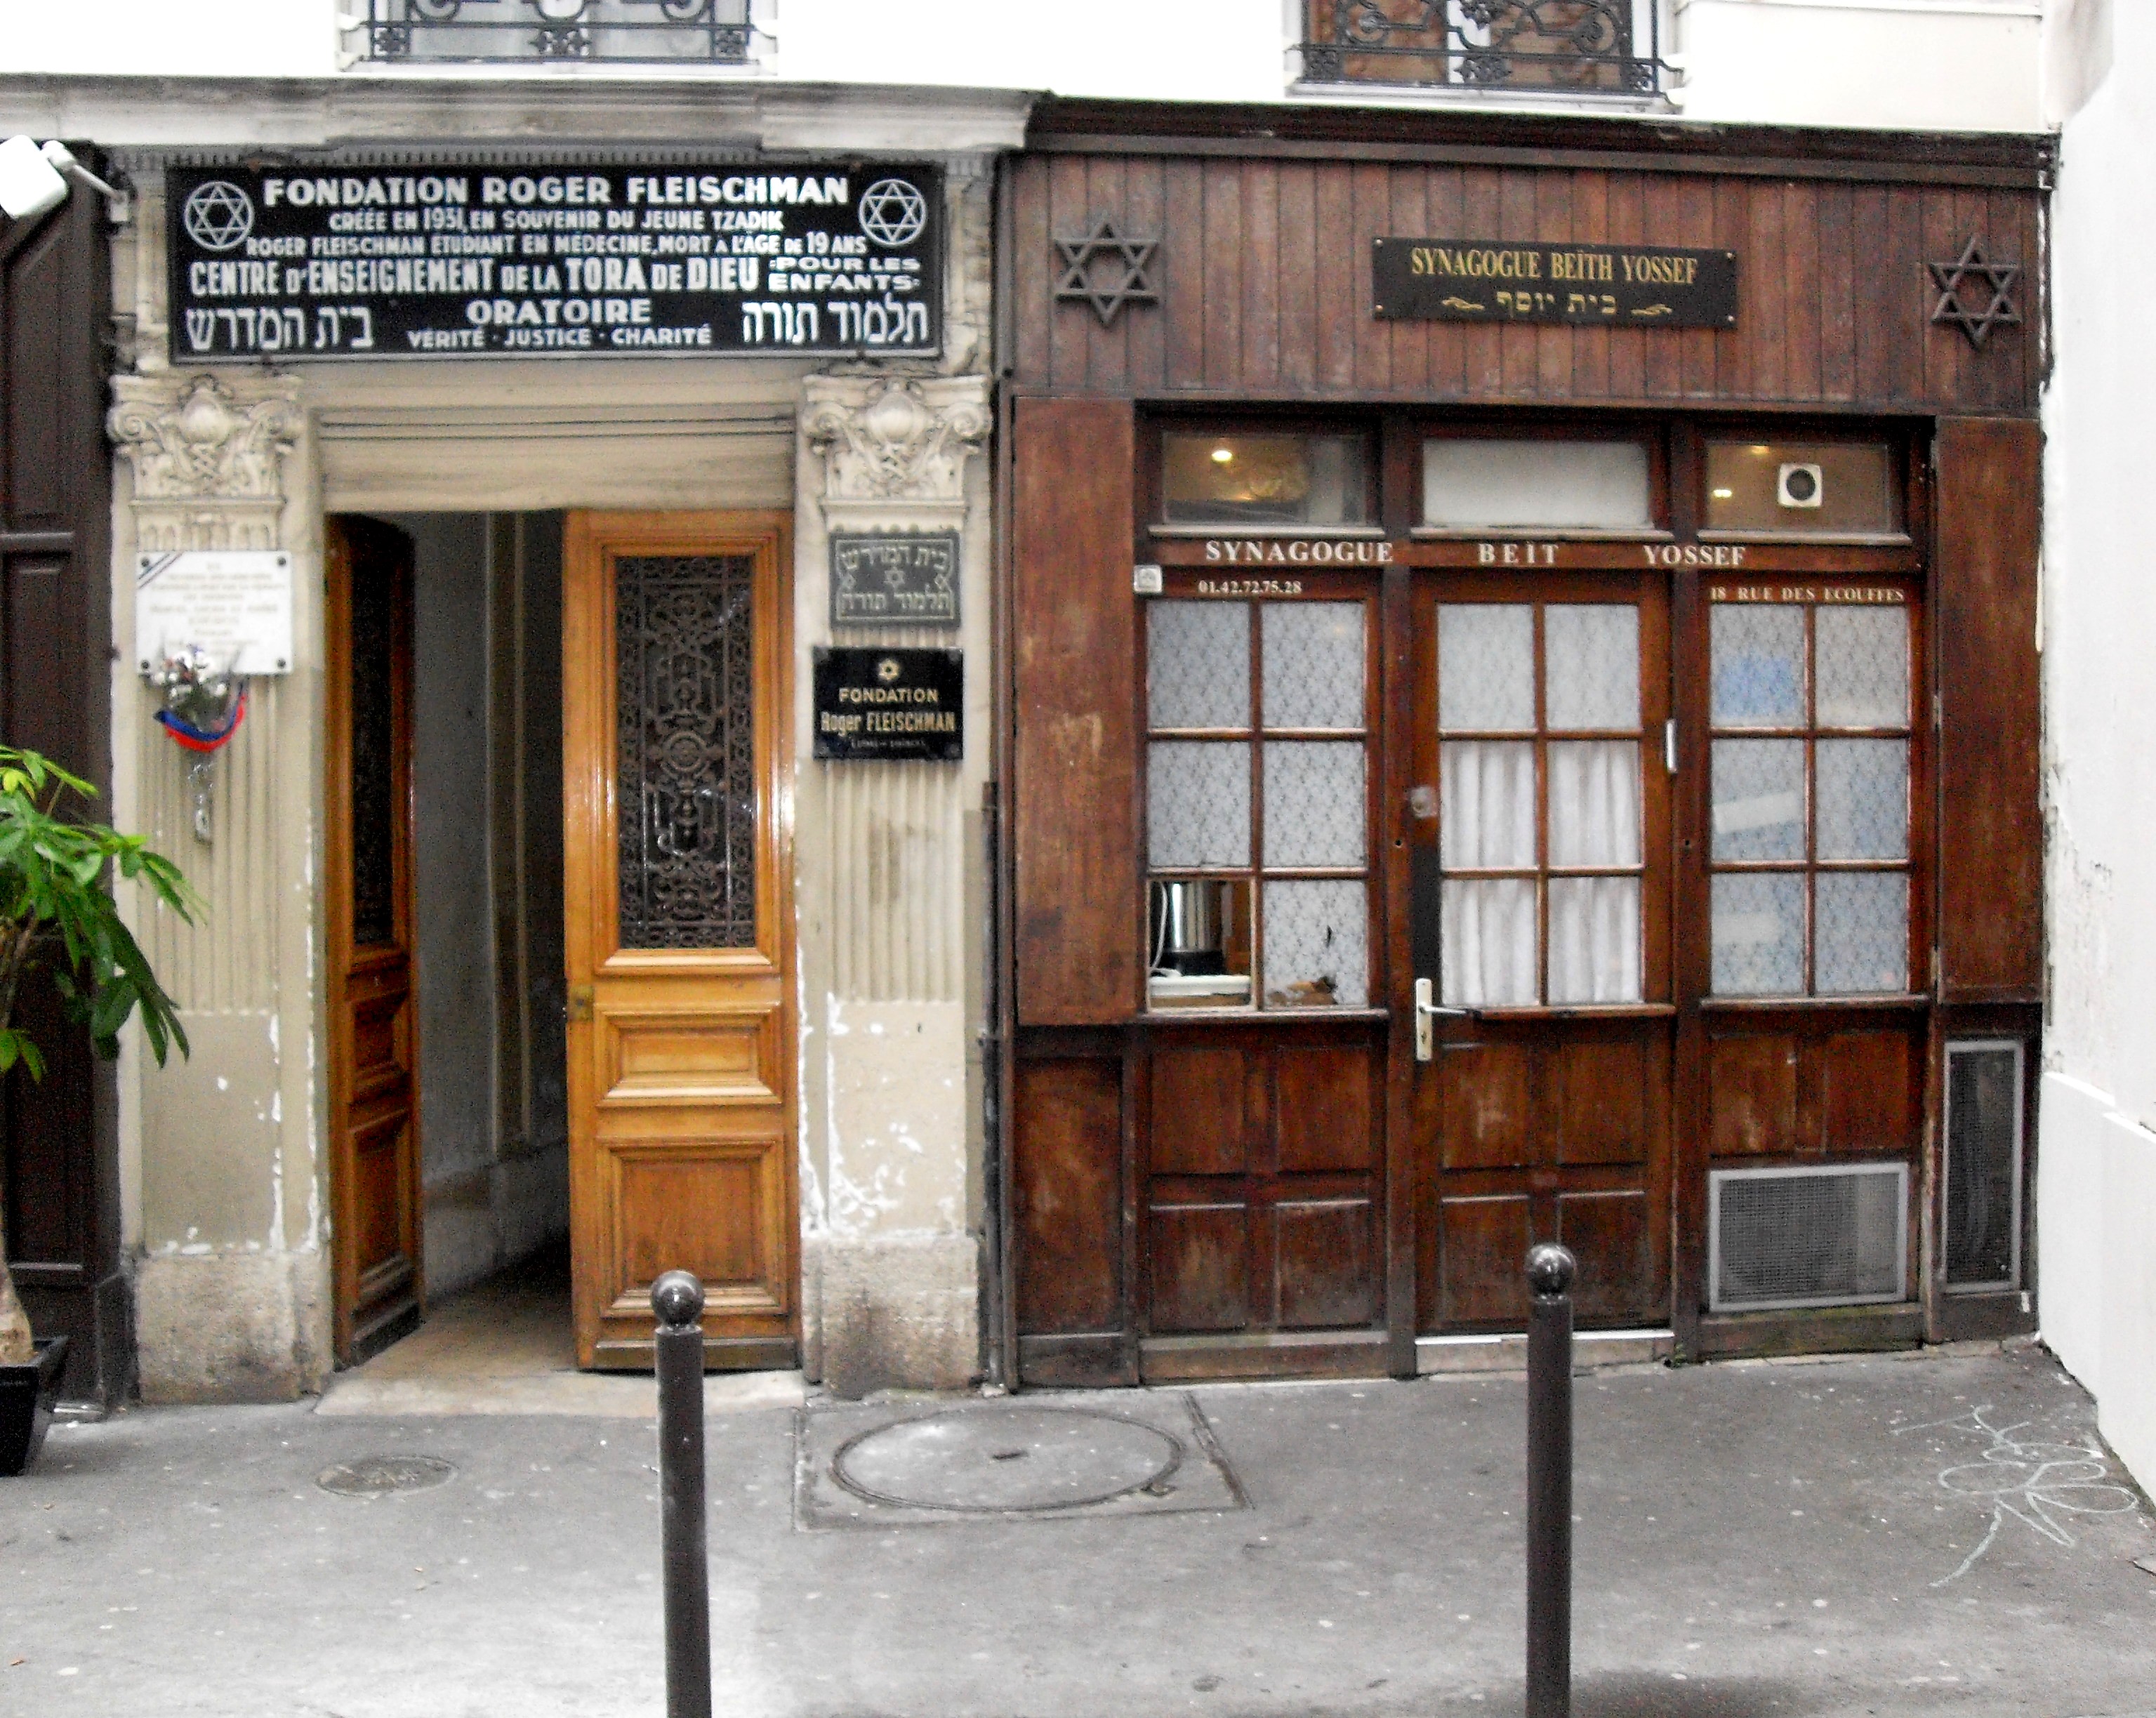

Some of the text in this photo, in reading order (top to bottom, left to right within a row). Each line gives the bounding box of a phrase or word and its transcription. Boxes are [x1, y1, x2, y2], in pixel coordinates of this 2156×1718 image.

[263, 176, 849, 206] FONDATION ROGER FLEISCHMAN
[392, 211, 418, 231] EN
[470, 211, 496, 230] EN
[502, 210, 602, 230] SOUVENIR
[607, 210, 635, 230] DU
[641, 210, 704, 230] JEUNE
[711, 210, 784, 230] TZADIK
[246, 235, 306, 256] ROGER
[312, 234, 424, 256] FLEISCHMAN
[522, 234, 548, 253] EN
[659, 234, 711, 253] MORT
[784, 238, 803, 253] DE
[806, 231, 829, 253] 19
[831, 235, 867, 253] ANS
[190, 260, 280, 296] CENTRE
[501, 265, 528, 291] DE
[532, 265, 561, 291] LA
[565, 257, 647, 291] TORA
[651, 263, 682, 291] DE
[687, 256, 759, 291] DIEU
[869, 257, 920, 271] LES
[1411, 247, 1541, 278] SYNAGOGUE
[1621, 254, 1698, 284] YOSSEF
[465, 298, 652, 325] ORATOIRE
[1496, 291, 1616, 318] בית יוסף
[185, 305, 373, 350] בית המדרש
[741, 292, 928, 344] תלמוד תורה
[504, 327, 591, 347] JUSTICE
[610, 324, 712, 345] CHARITÉ
[914, 546, 948, 571] בית
[1205, 539, 1394, 562] SYNAGOGUE
[1643, 545, 1747, 565] YOSSEF
[1709, 586, 1727, 601] 18
[1737, 586, 1774, 602] RUE
[1781, 586, 1817, 602] DES
[838, 687, 939, 703] FONDATION
[820, 711, 955, 737] Roger FLEISCHMAN
